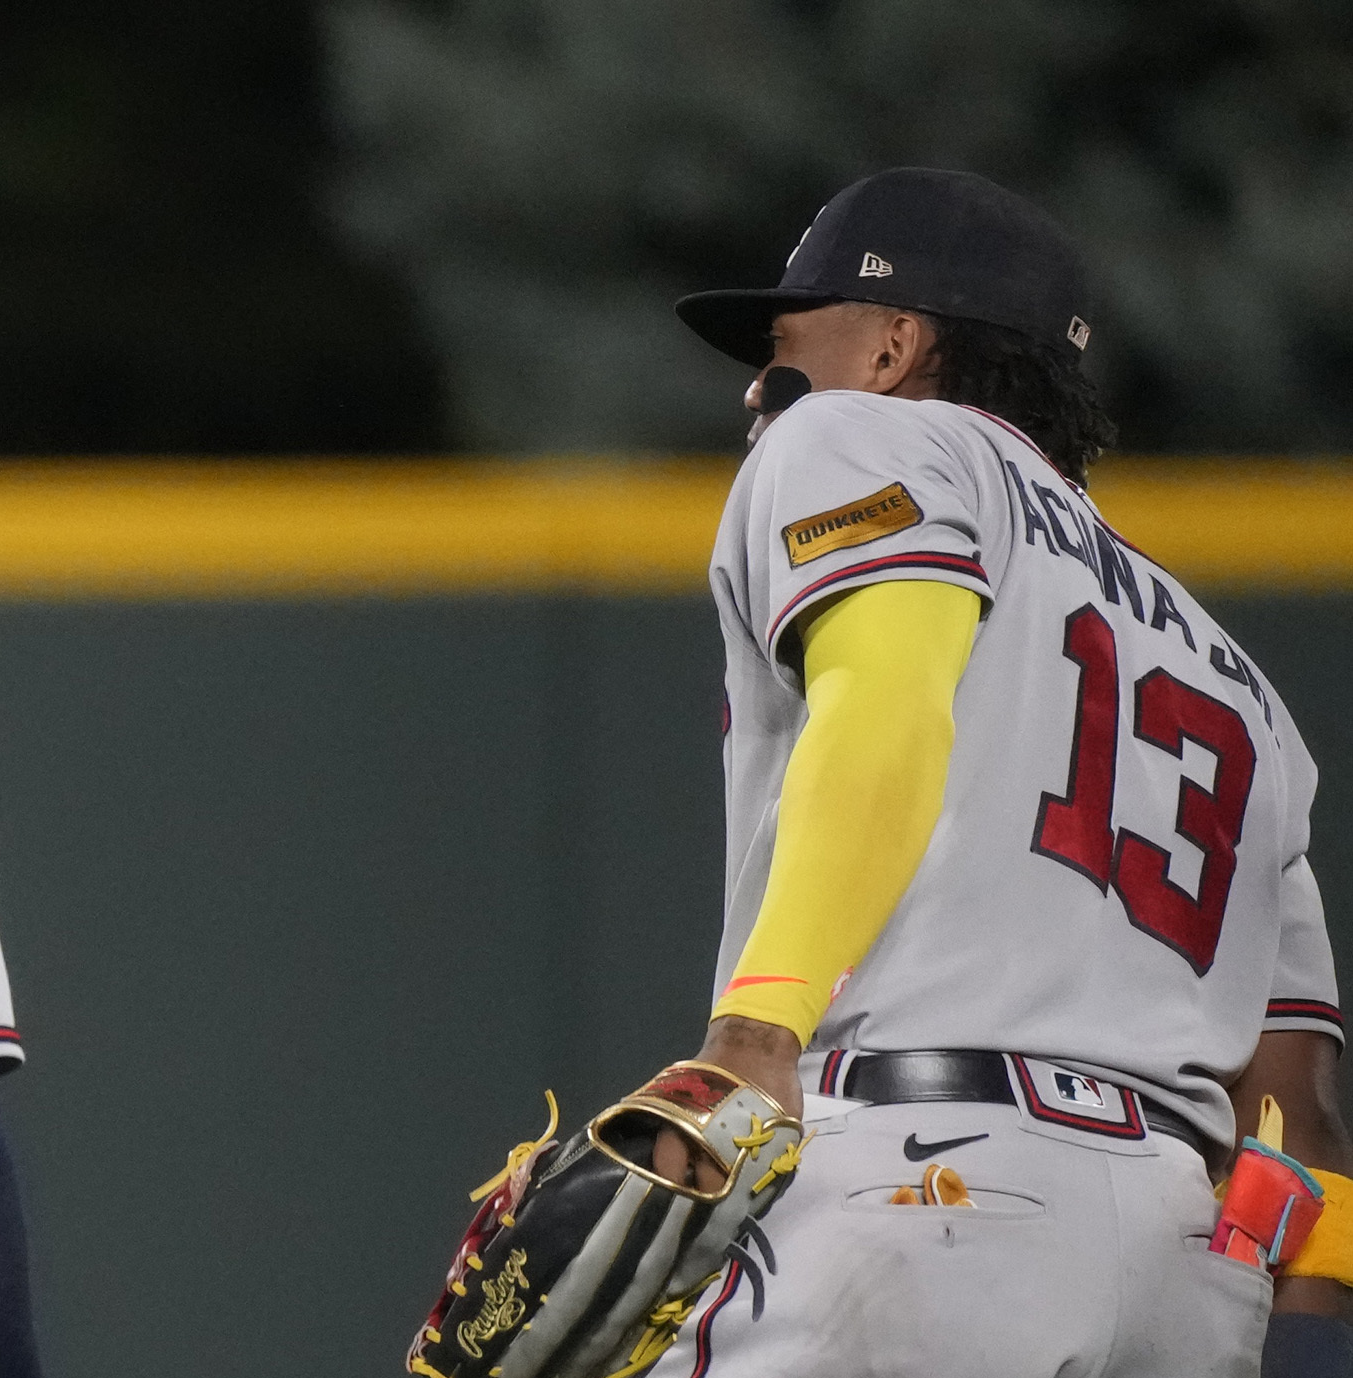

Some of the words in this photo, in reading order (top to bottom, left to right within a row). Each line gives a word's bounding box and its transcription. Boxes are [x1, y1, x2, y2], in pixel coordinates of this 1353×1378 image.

[795, 494, 904, 546] QUIKRETE
[1030, 601, 1258, 978] 13
[457, 1247, 530, 1358] Rawlings
